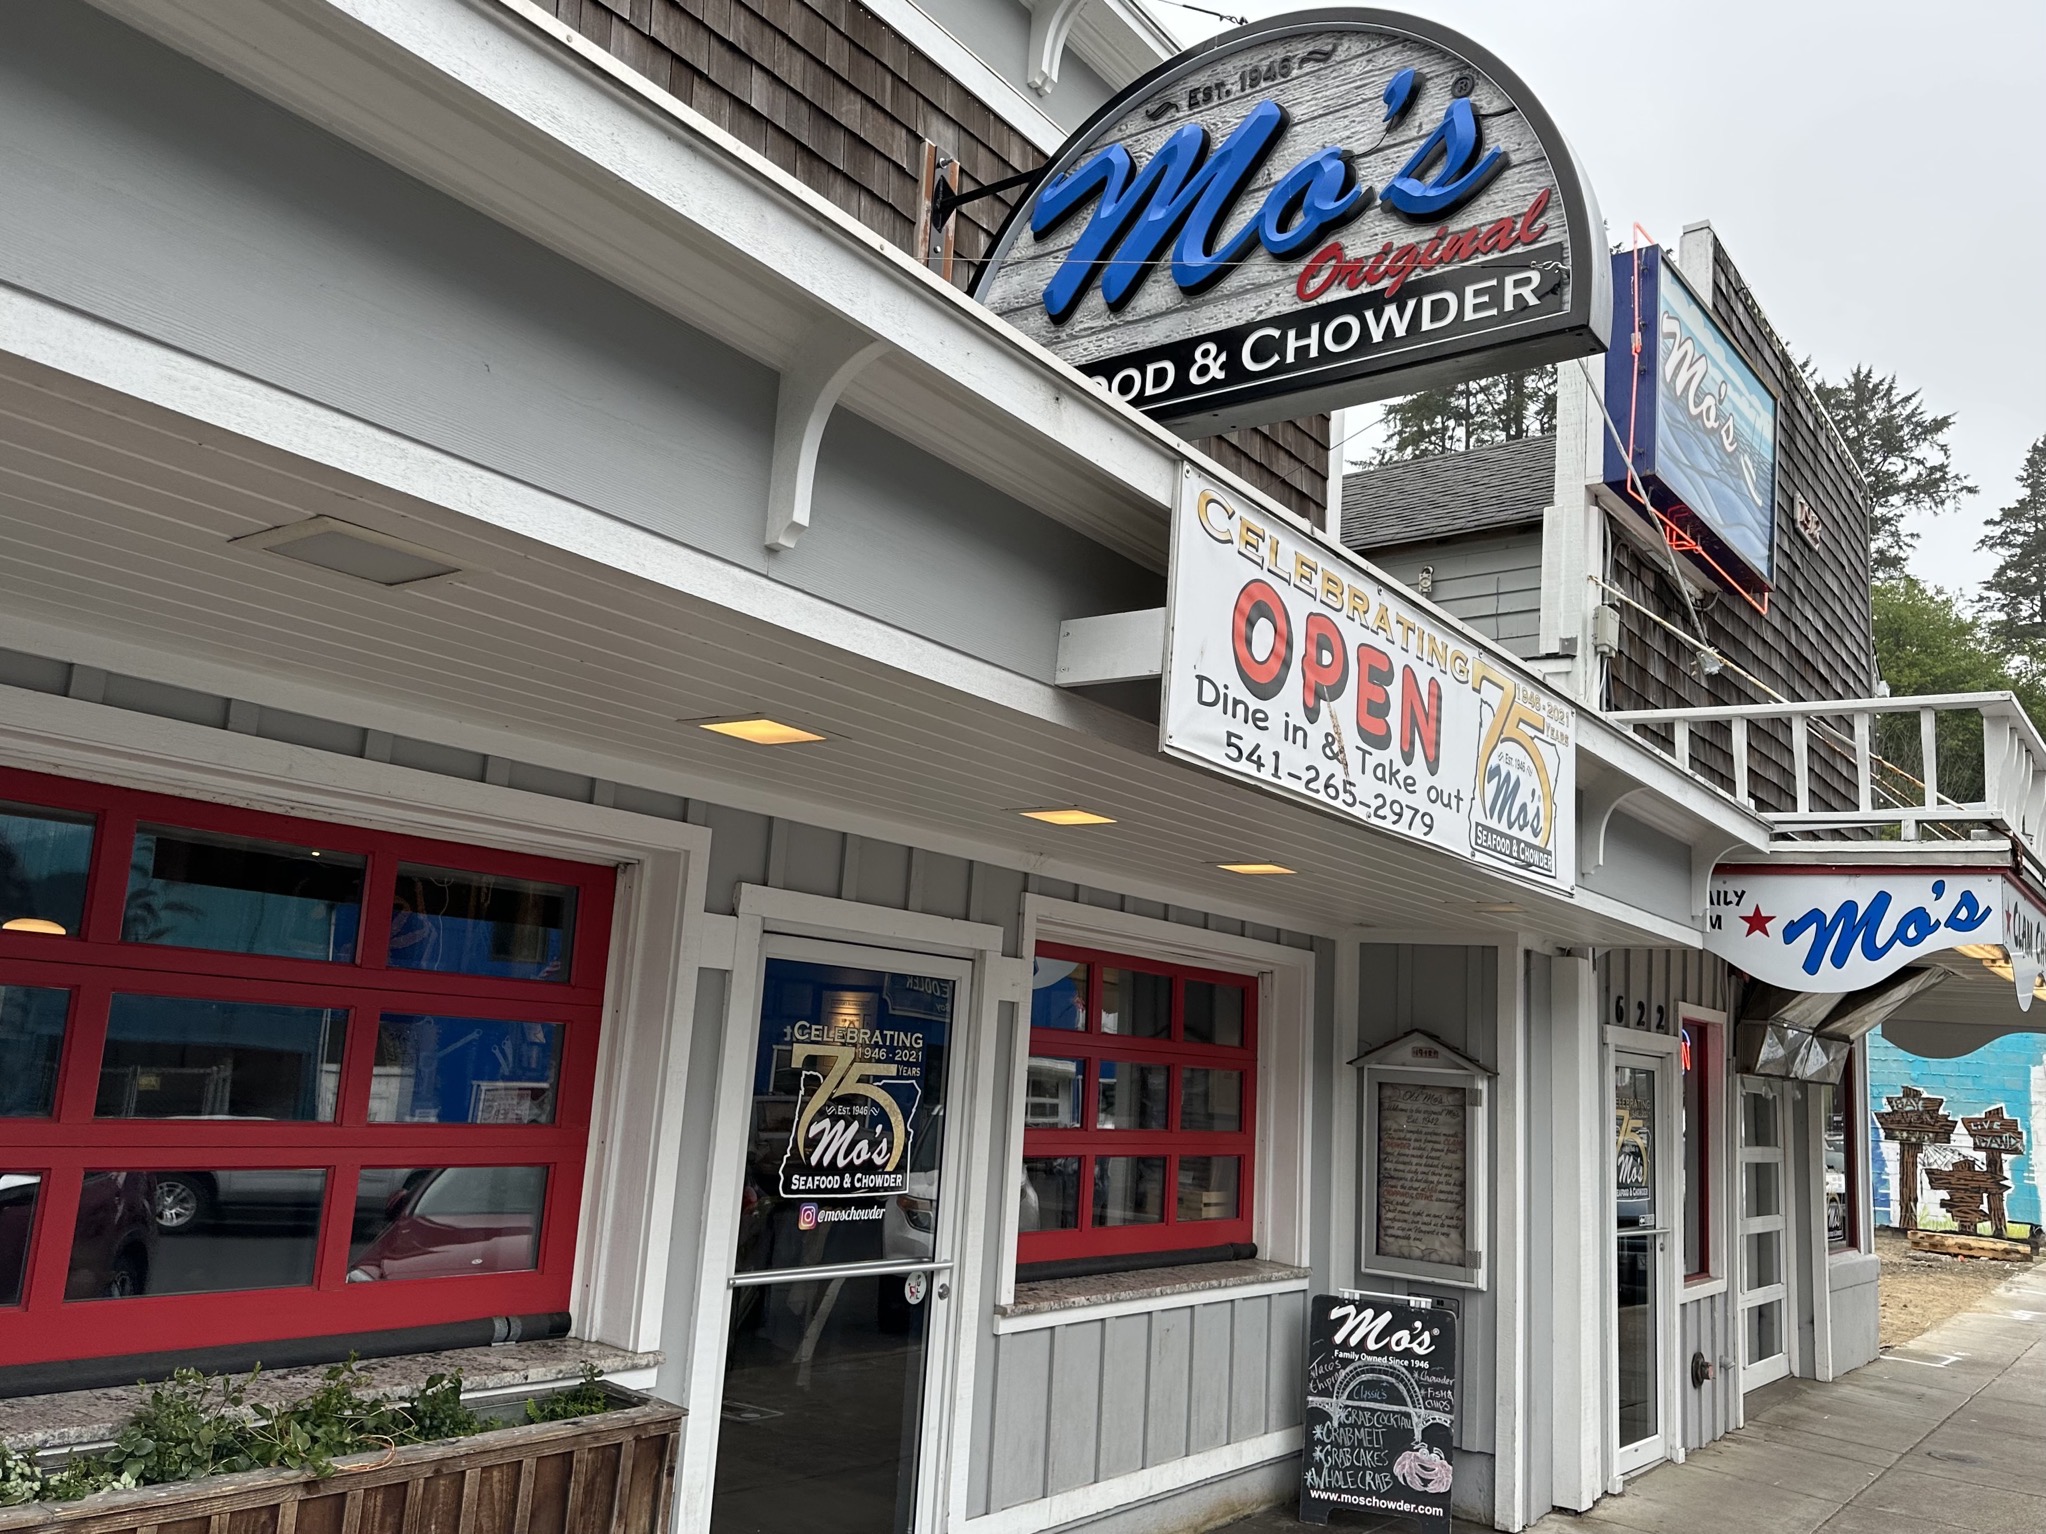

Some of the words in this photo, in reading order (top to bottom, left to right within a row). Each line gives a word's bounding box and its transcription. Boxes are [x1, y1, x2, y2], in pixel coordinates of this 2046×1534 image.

[1187, 81, 1232, 108] EST.
[1239, 56, 1293, 92] 1946
[1031, 67, 1509, 326] Mo's
[1298, 188, 1550, 302] Original
[1189, 341, 1227, 385] &
[1241, 270, 1543, 372] CHOWDER
[1661, 311, 1737, 453] Mo's
[1197, 489, 1470, 685] CELEBRATING
[1232, 578, 1442, 776] OPEN
[1546, 701, 1569, 728] 2021
[1546, 722, 1569, 747] YEARS
[1194, 673, 1270, 733] Dine
[1284, 713, 1308, 750] in
[1321, 732, 1346, 764] &
[1356, 744, 1417, 795] Take
[1427, 784, 1464, 814] out
[1472, 657, 1554, 848] 75
[1224, 730, 1436, 838] 541-265-2979
[1487, 763, 1542, 838] Mo's
[1476, 825, 1511, 854] SEAFOOD
[1512, 839, 1518, 857] &
[1520, 842, 1552, 871] CHOWDER
[1782, 879, 1993, 976] Mo's
[793, 1020, 923, 1048] CELEBRATING
[858, 1047, 887, 1060] 1946
[895, 1050, 922, 1062] 2021
[898, 1065, 920, 1077] YEARS
[791, 1043, 905, 1172] 75
[852, 1105, 868, 1115] 1946
[809, 1118, 890, 1168] Mo's
[791, 1174, 840, 1189] SEAFOOD
[843, 1173, 851, 1188] &
[854, 1173, 902, 1187] CHOWDER
[1618, 1154, 1644, 1184] Mo's
[817, 1205, 886, 1222] @moschowder
[1328, 1305, 1436, 1355] Mo's
[1333, 1349, 1359, 1361] Family
[1361, 1353, 1387, 1363] Owned
[1388, 1356, 1409, 1367] Since
[1411, 1359, 1429, 1369] 1946
[1322, 1445, 1352, 1468] CRAB
[1354, 1449, 1389, 1467] CAKES
[1323, 1421, 1353, 1445] CRAB
[1354, 1428, 1387, 1449] MELT
[1310, 1489, 1444, 1517] www.moschowder.com
[1312, 1468, 1356, 1490] WHOLE
[1358, 1470, 1394, 1493] CRAB
